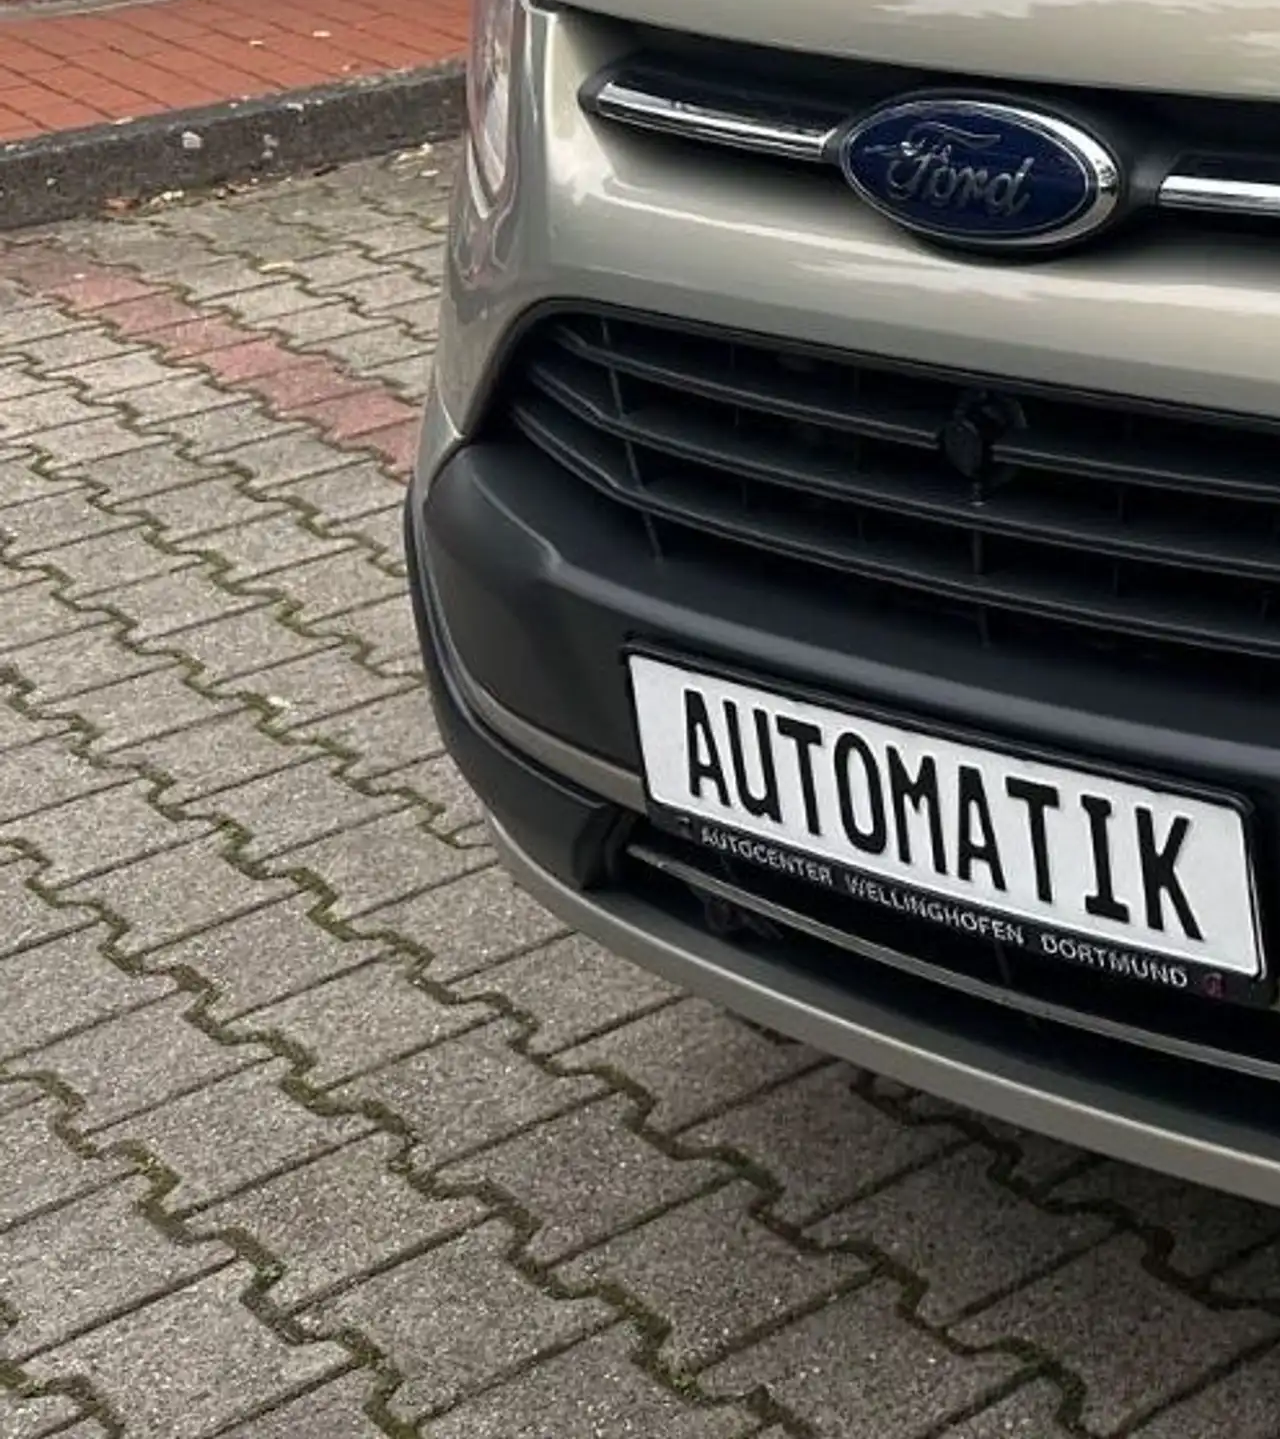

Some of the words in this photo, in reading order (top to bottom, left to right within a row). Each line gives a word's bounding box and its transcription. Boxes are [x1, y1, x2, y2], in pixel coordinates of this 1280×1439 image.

[863, 121, 1035, 216] Ford
[682, 687, 1204, 943] AUTOMATIK
[701, 826, 832, 887] AUTOCENTER
[845, 872, 1024, 946] WELLINGHOFEN
[1040, 933, 1188, 988] DORTMUND
